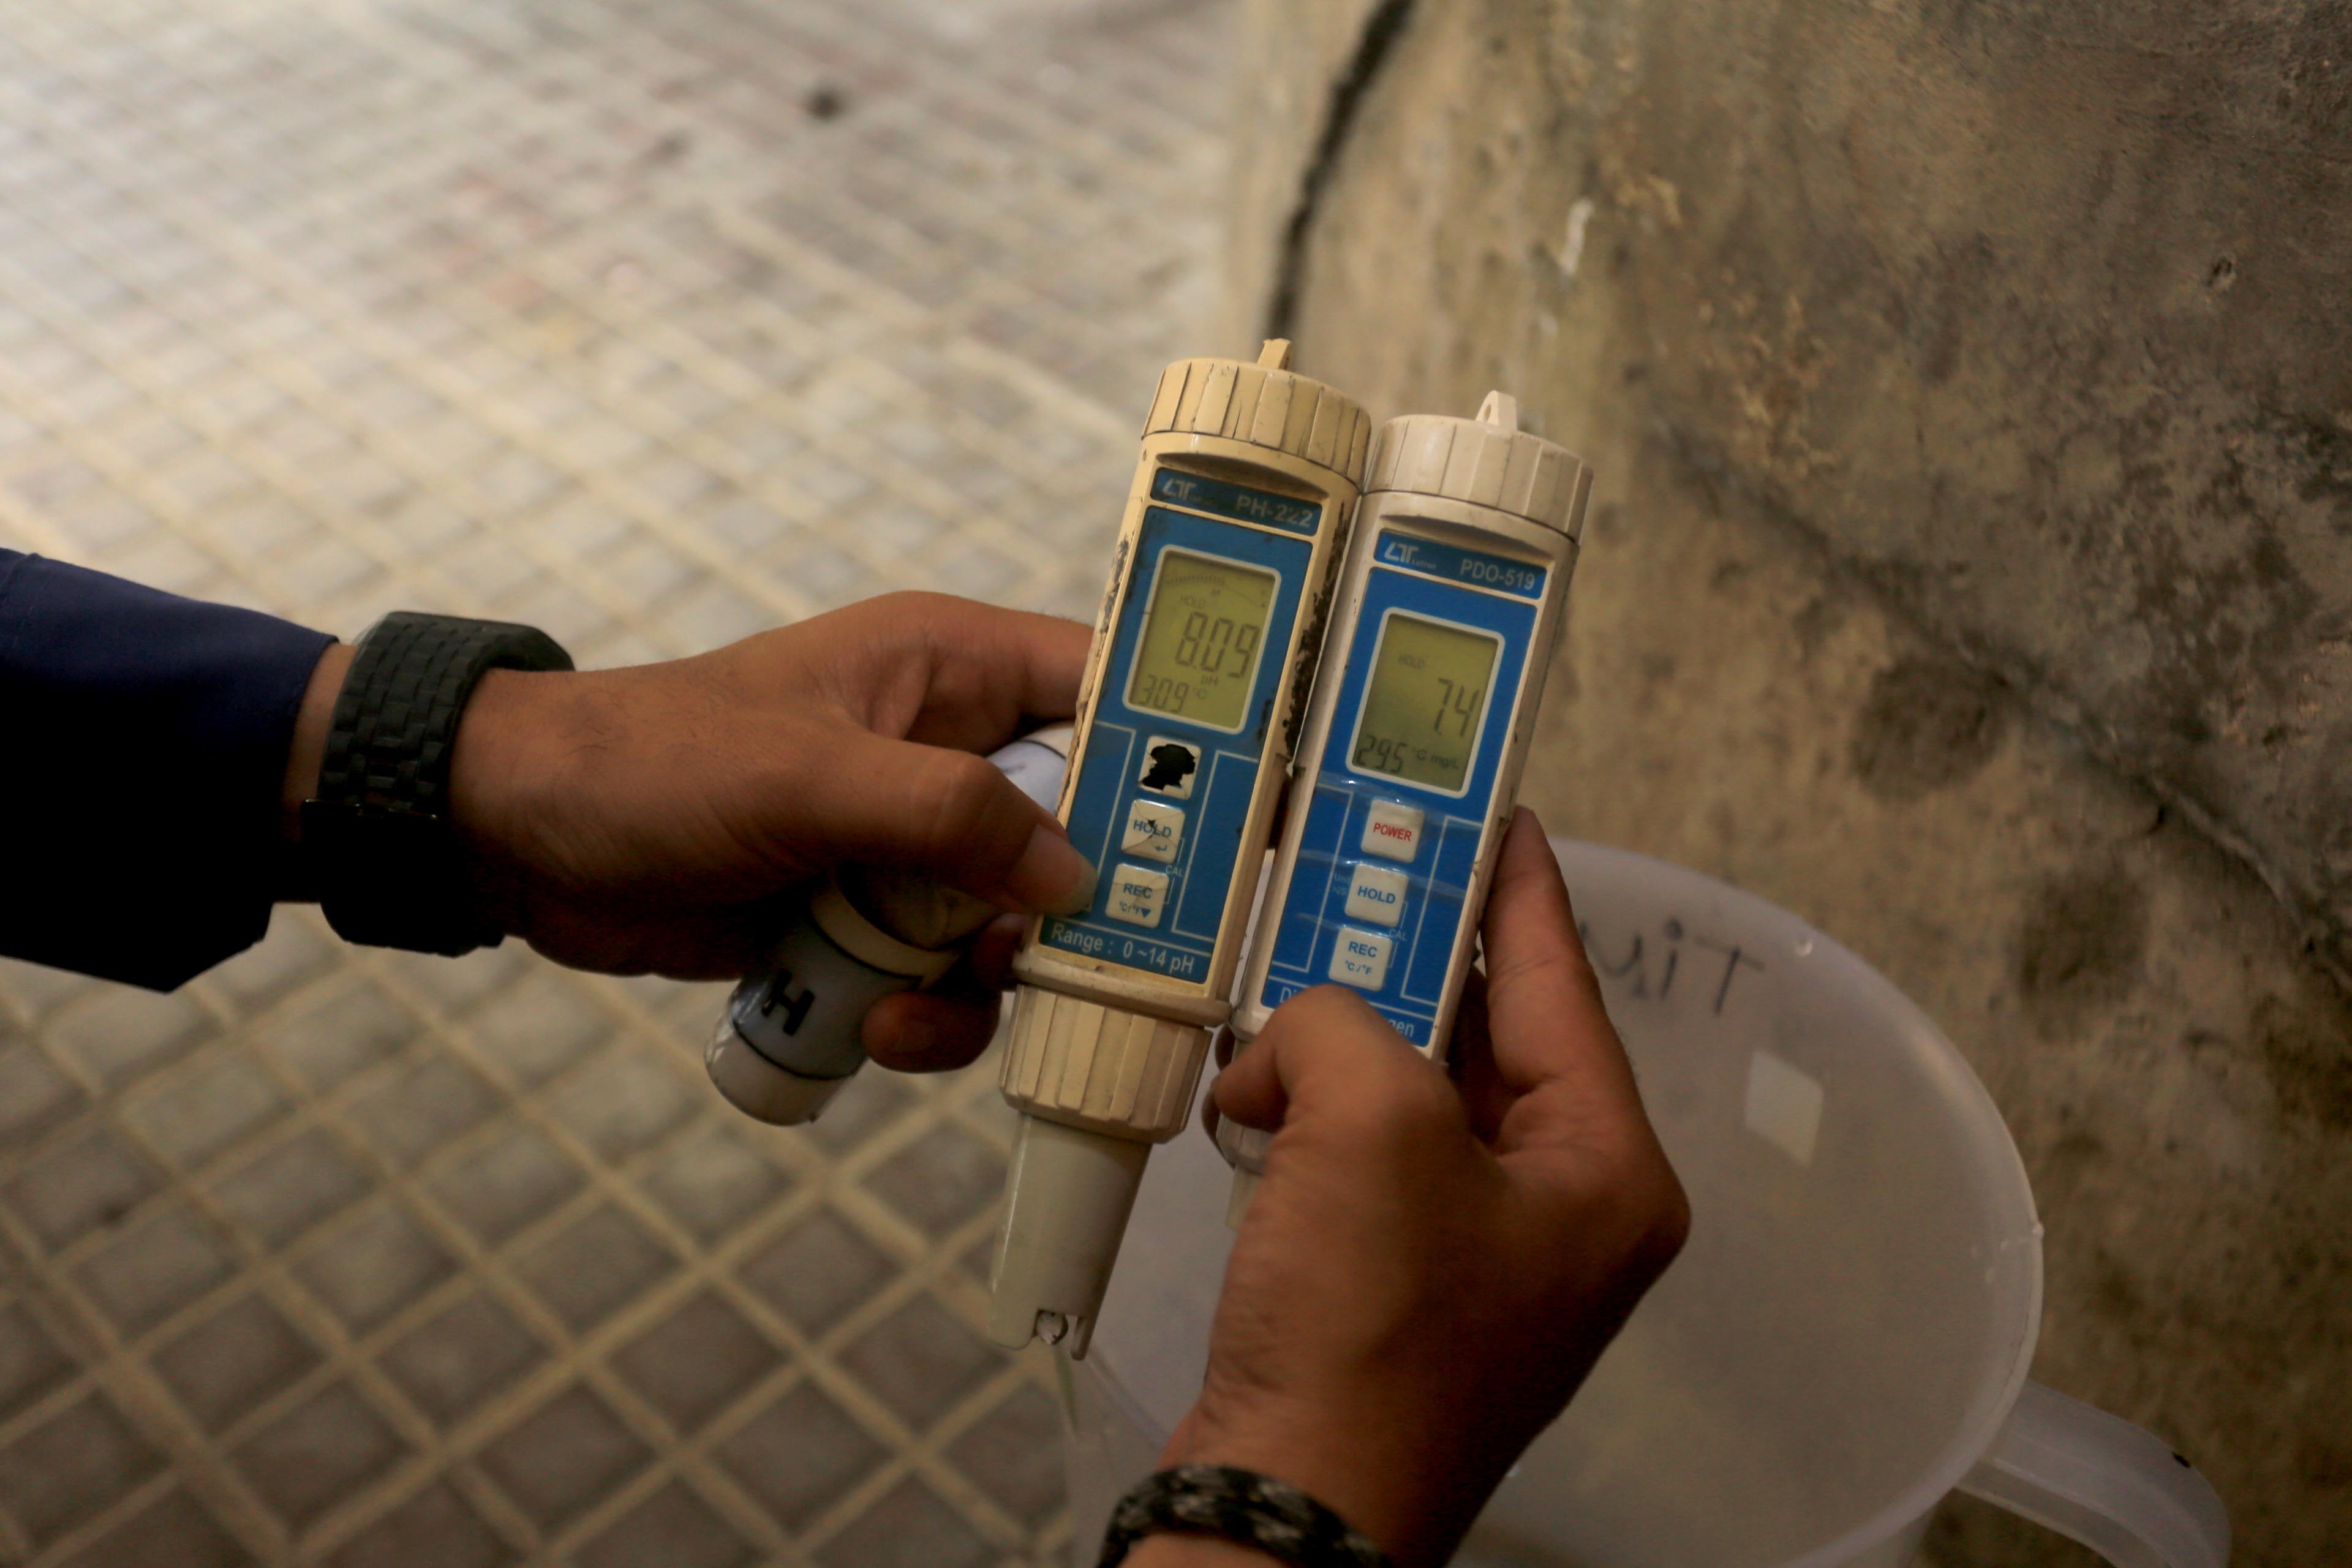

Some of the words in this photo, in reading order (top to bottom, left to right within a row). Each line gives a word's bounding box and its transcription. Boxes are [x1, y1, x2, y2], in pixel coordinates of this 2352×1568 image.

[1234, 493, 1314, 528] PH-222
[1411, 557, 1437, 570] Lutron
[1460, 557, 1536, 590] PDO-519
[1133, 820, 1173, 839] HOLD
[1373, 822, 1412, 842] POWER
[1165, 864, 1184, 878] CAL
[1123, 882, 1153, 900] REC
[1357, 884, 1396, 905] HOLD
[1389, 928, 1408, 942] CAL
[1348, 940, 1378, 959] REC
[1169, 956, 1195, 975] pH
